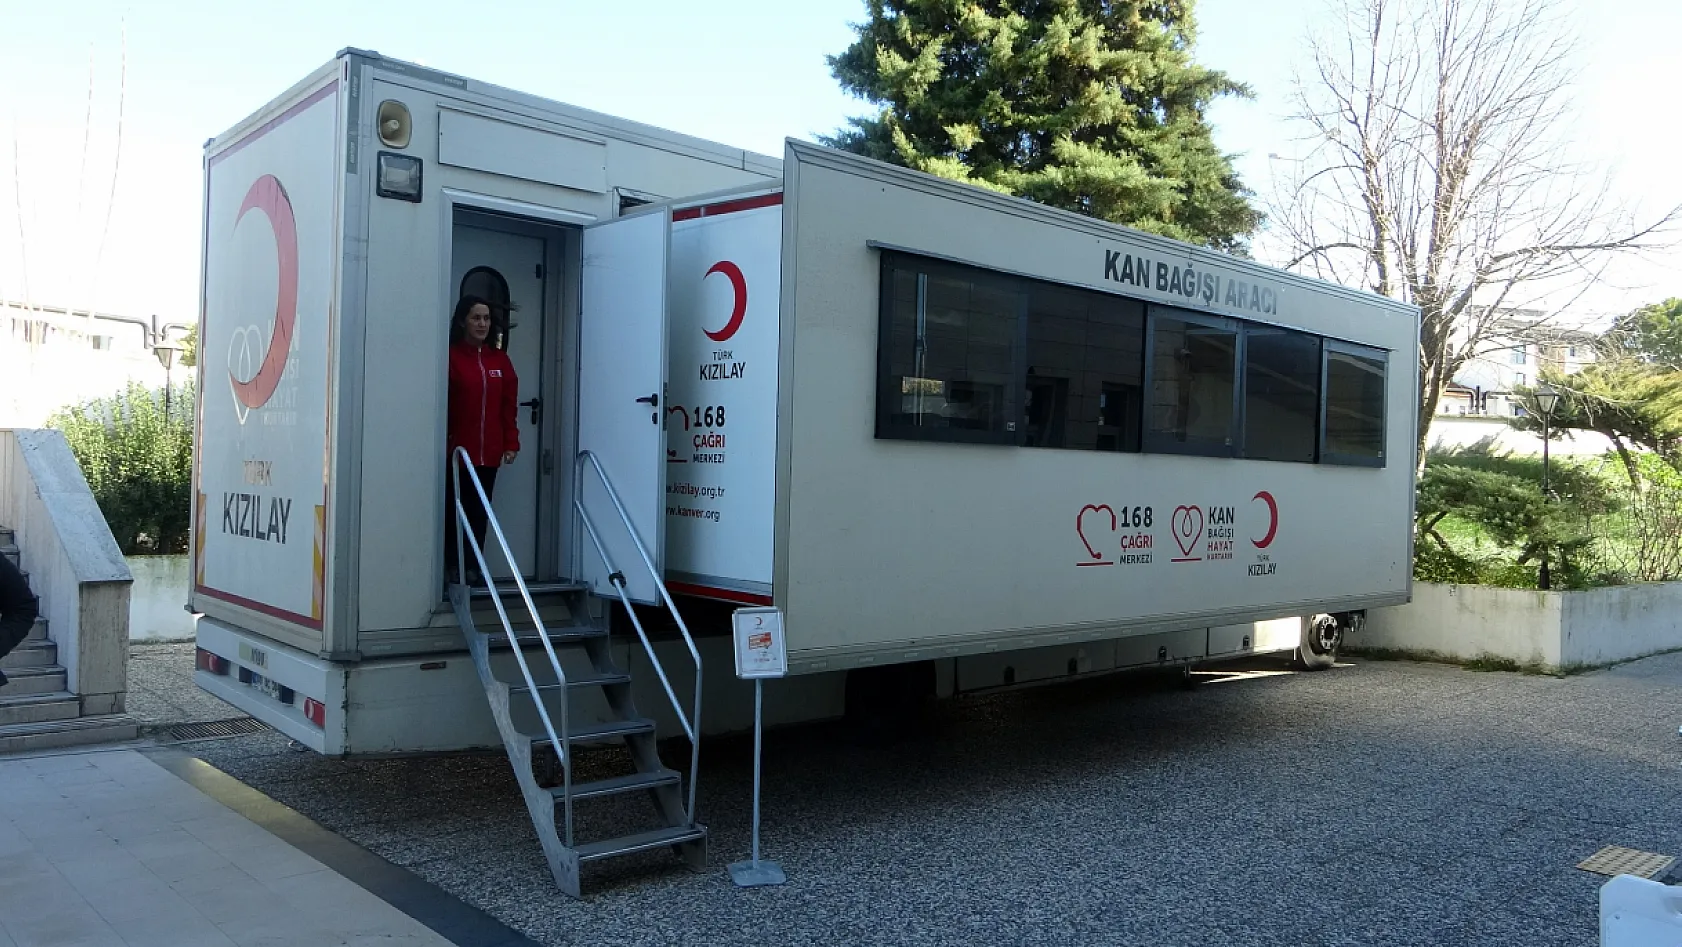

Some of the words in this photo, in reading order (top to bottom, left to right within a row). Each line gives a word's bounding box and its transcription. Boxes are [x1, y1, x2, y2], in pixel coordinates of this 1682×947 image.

[1104, 250, 1150, 289] KAN
[1156, 262, 1220, 306] BAĞIŞI
[1224, 278, 1277, 315] ARACI
[713, 350, 733, 361] TÜRK
[700, 362, 746, 380] KIZILAY
[693, 405, 725, 428] 168
[693, 431, 725, 451] ÇAĞRI
[692, 452, 725, 463] MERKEZİ
[223, 492, 292, 545] KIZILAY
[1121, 506, 1153, 527] 168
[1208, 506, 1235, 525] KAN
[1120, 532, 1153, 552] ÇAĞRI
[1208, 526, 1234, 540] BAĞIŞI
[1207, 541, 1233, 551] HAYAT
[1119, 553, 1153, 565] MERKEZİ
[1248, 563, 1277, 576] KIZILAY
